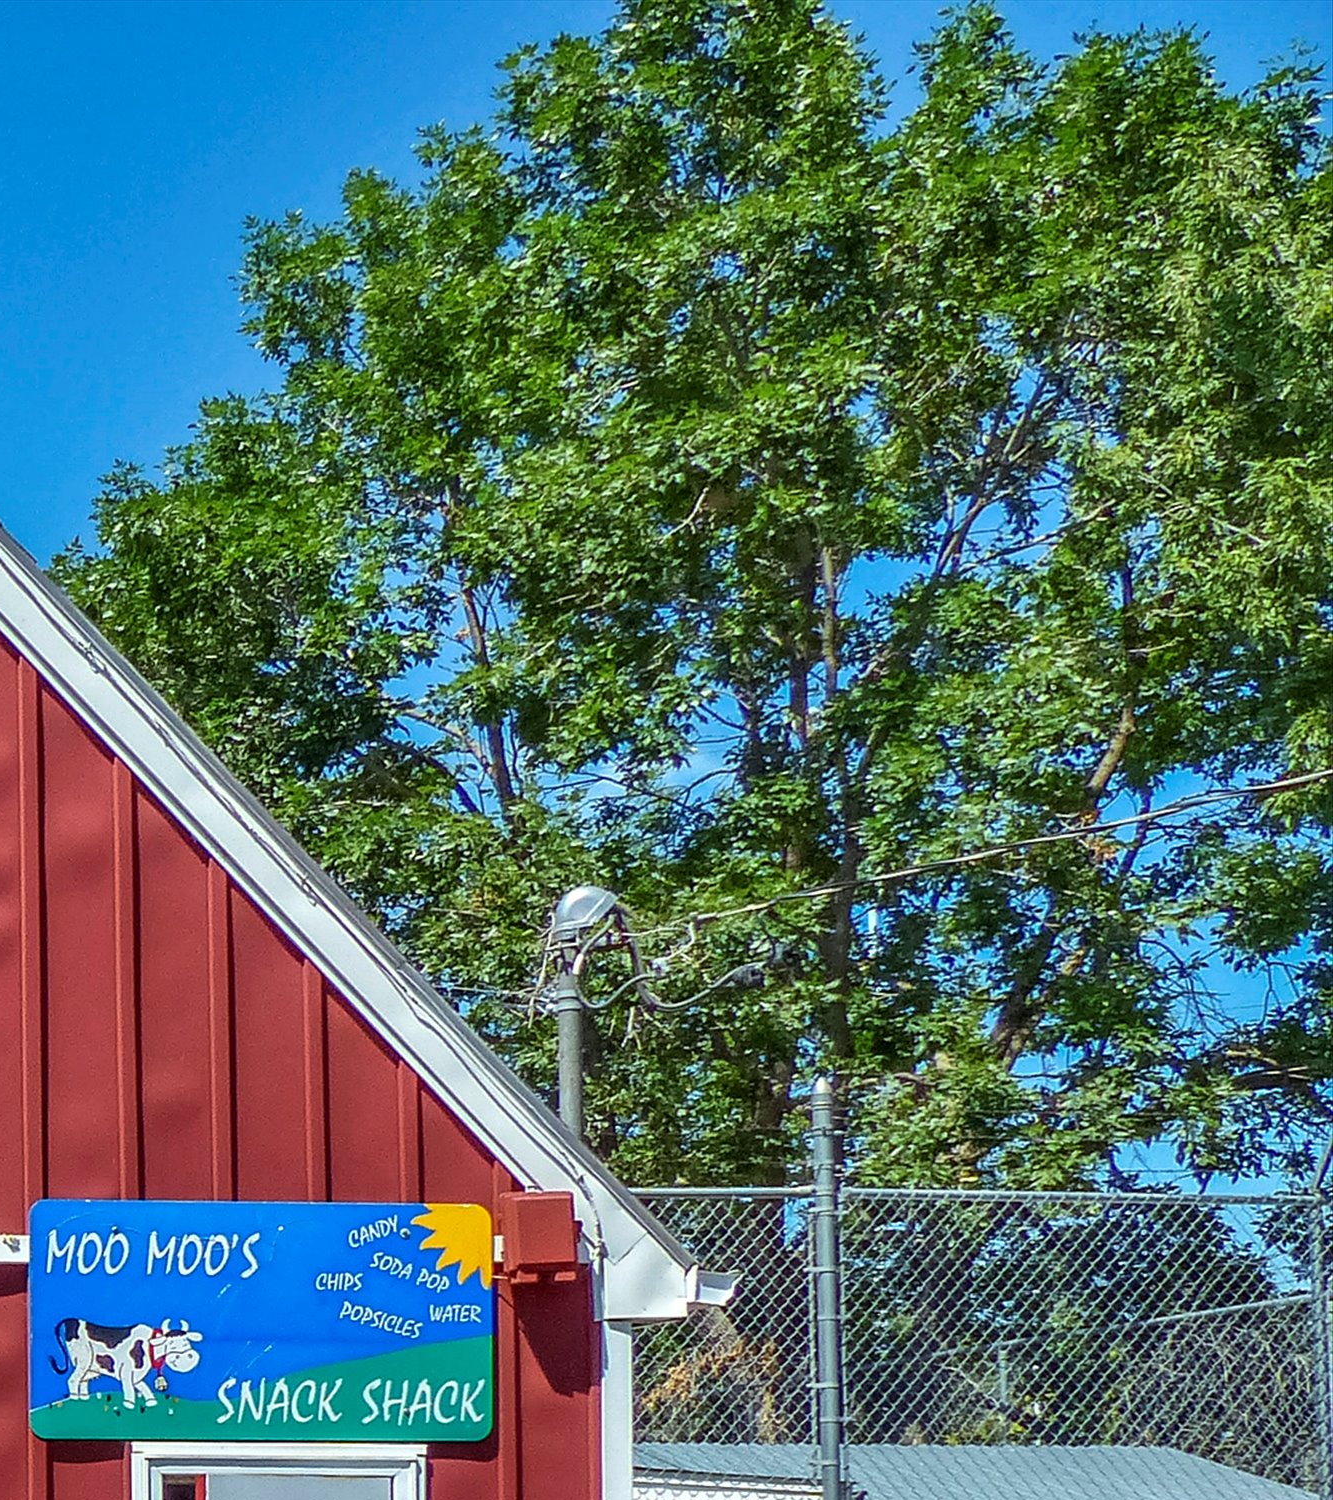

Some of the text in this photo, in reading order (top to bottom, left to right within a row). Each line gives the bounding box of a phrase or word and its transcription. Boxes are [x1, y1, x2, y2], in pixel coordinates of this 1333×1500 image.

[347, 1215, 399, 1248] CANDY
[46, 1229, 261, 1280] MOO MOO'S
[370, 1251, 450, 1294] SODA POP
[315, 1273, 364, 1292] CHIPS
[339, 1301, 423, 1339] POPSICLES
[429, 1304, 481, 1323] WATER
[216, 1377, 486, 1427] SNACK SHACK
